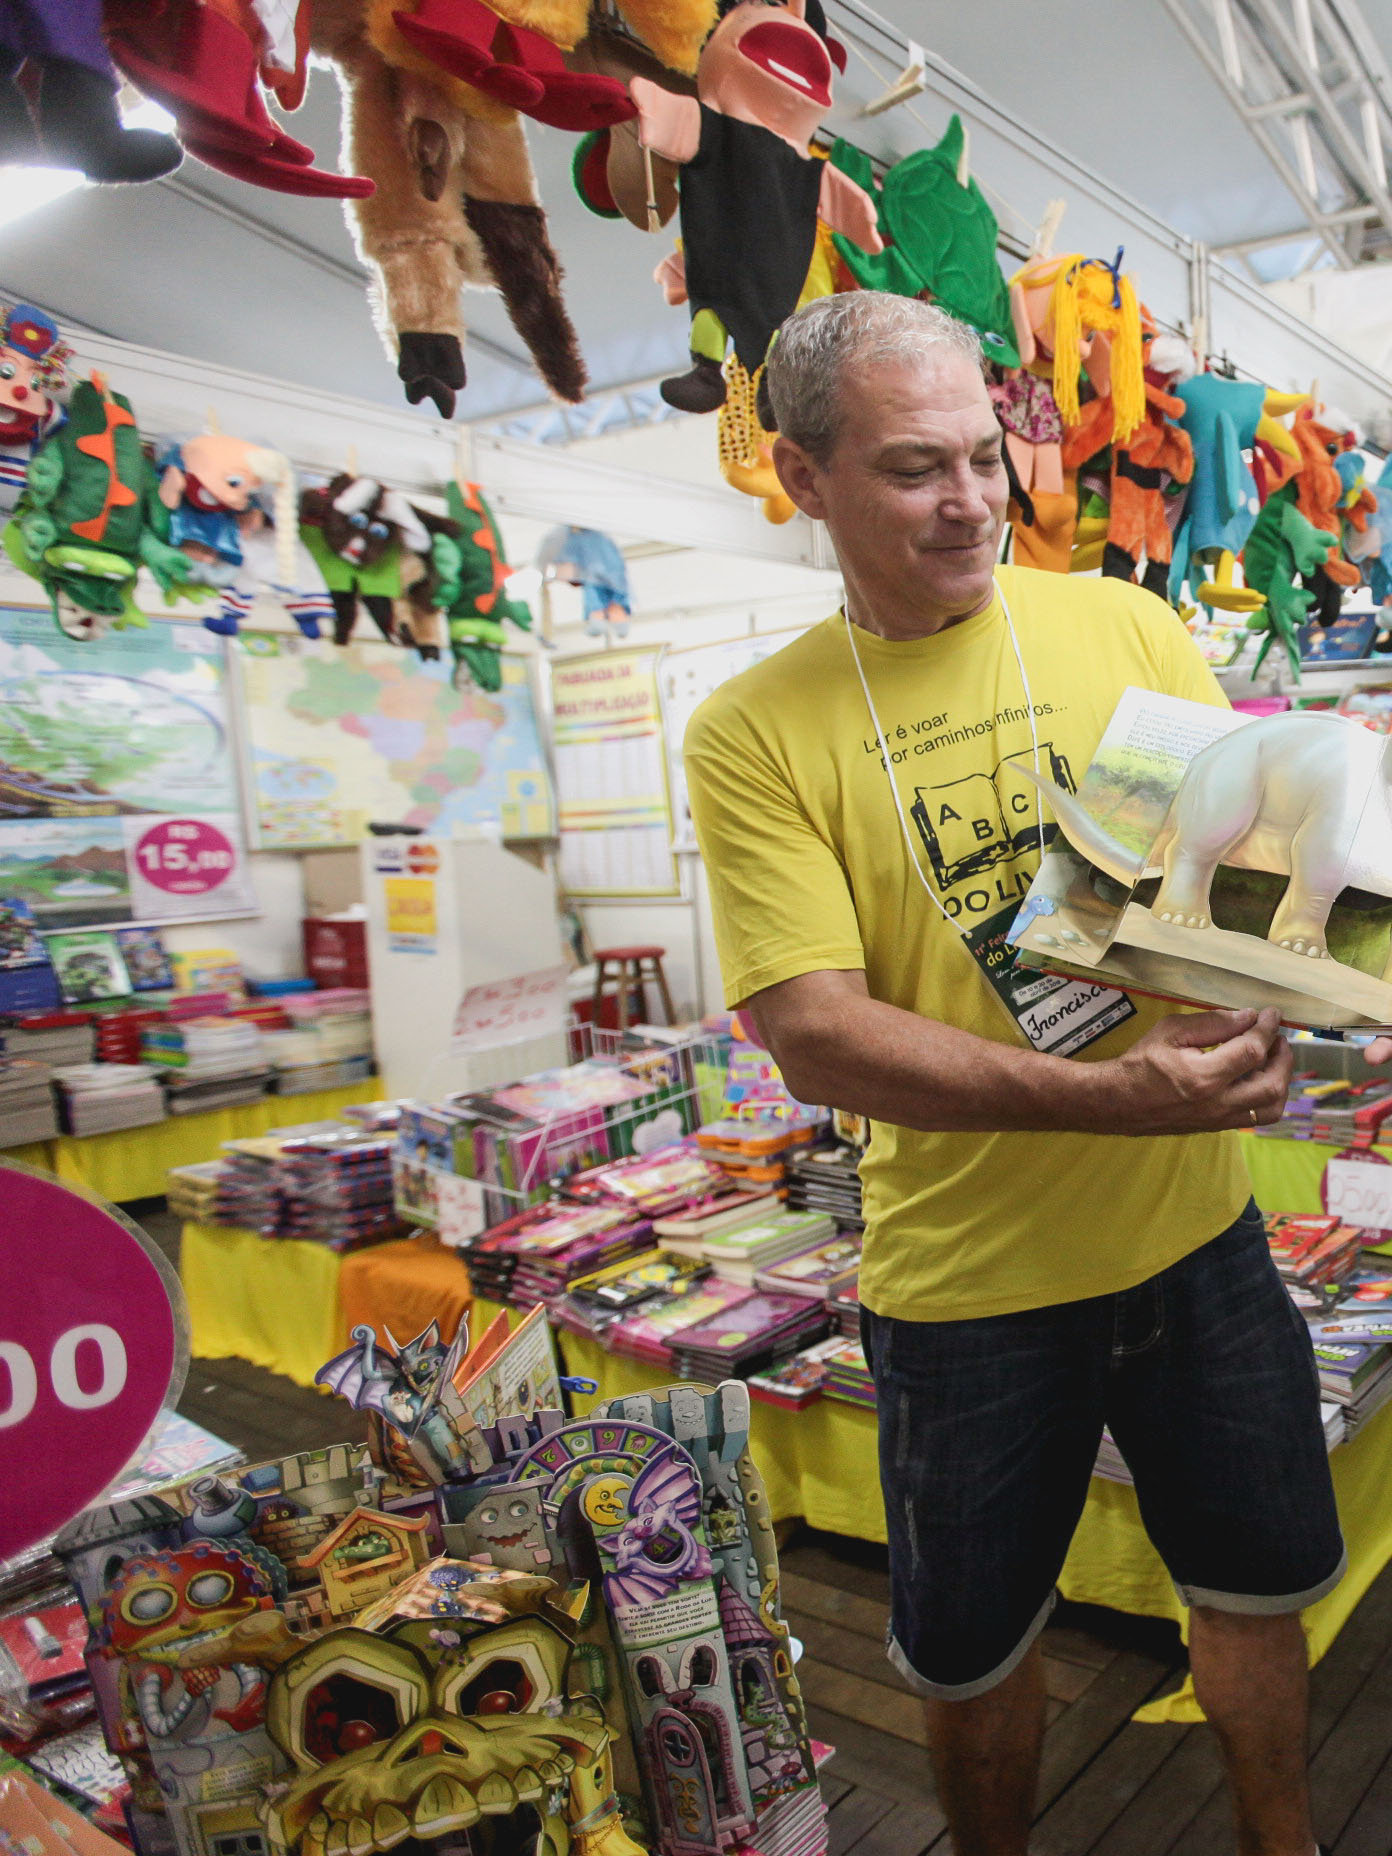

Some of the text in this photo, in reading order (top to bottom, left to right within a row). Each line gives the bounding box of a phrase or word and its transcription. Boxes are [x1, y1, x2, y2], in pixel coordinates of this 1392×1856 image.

[896, 725, 907, 739] é
[911, 712, 948, 734] voar
[914, 719, 993, 755] caminhos
[940, 794, 1029, 840] A B C
[141, 843, 232, 874] 15,00
[943, 890, 990, 920] DO
[986, 951, 1004, 967] do
